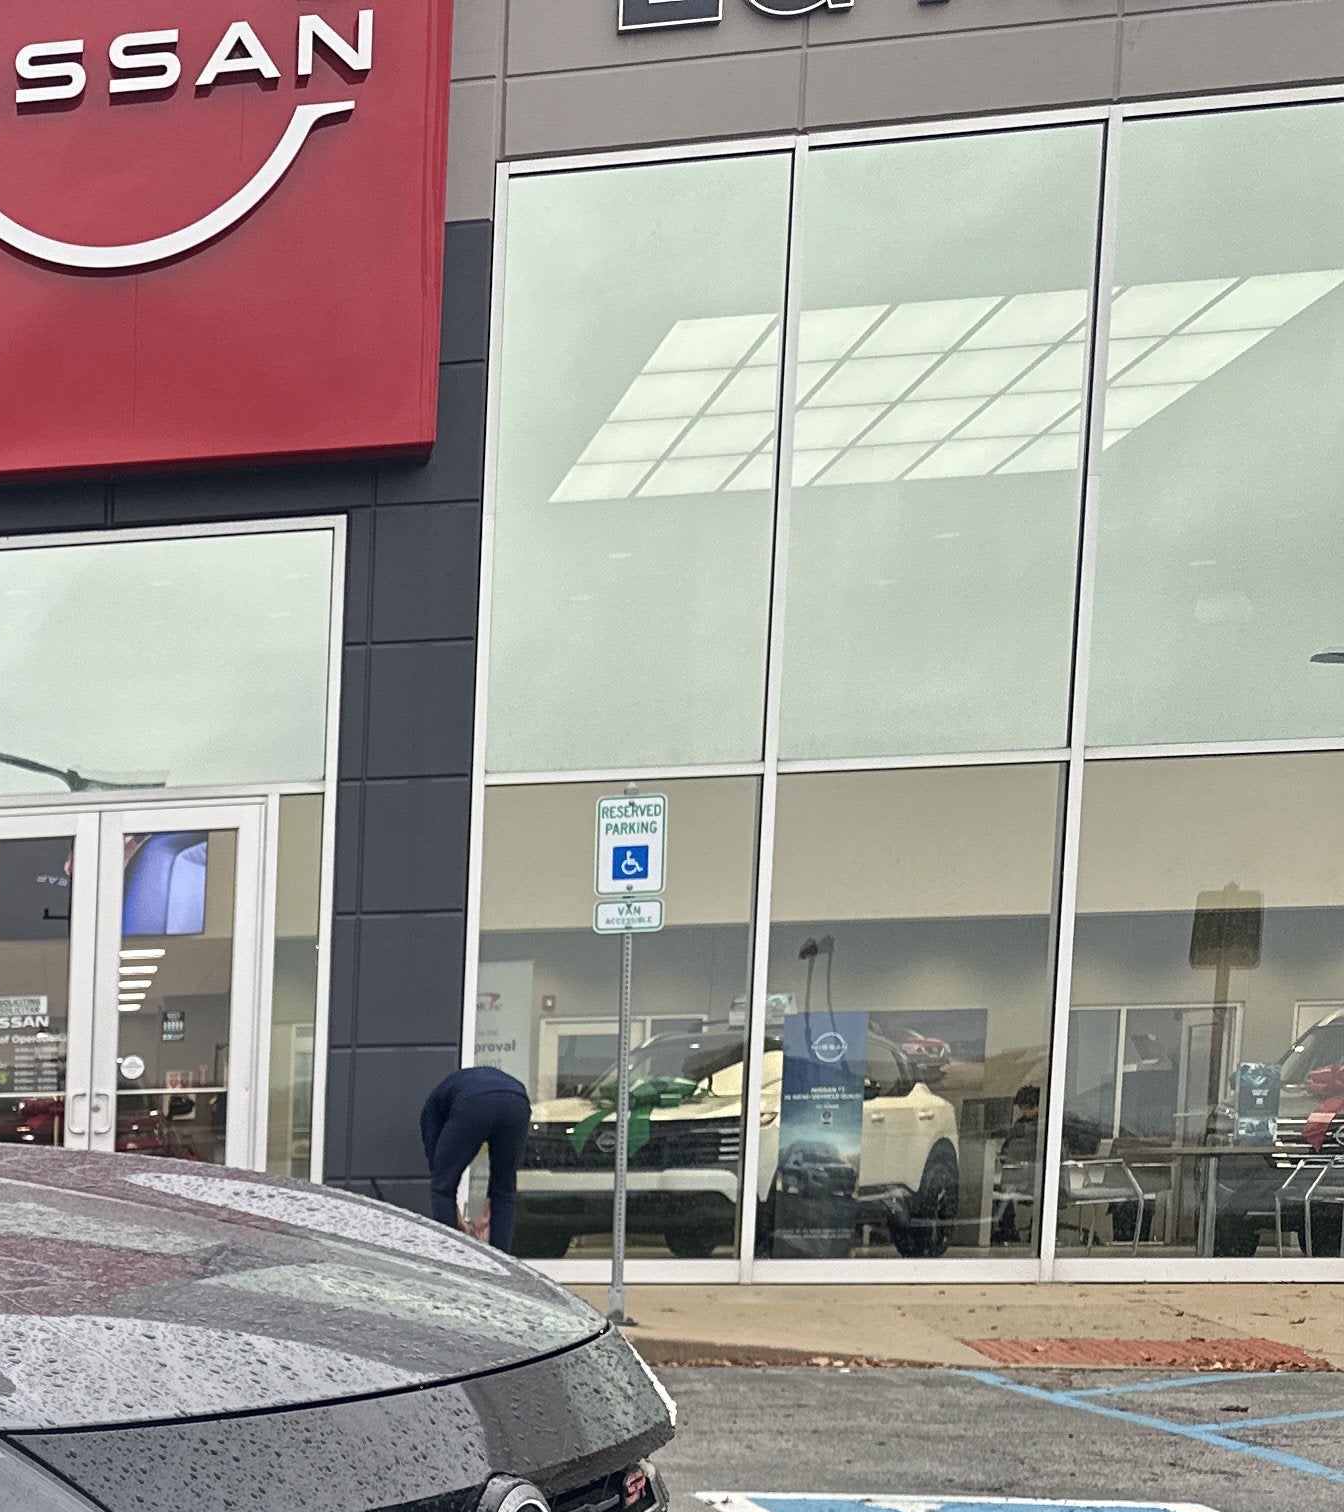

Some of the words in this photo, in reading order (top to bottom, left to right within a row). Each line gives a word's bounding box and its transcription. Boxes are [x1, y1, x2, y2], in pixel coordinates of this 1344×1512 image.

[601, 804, 661, 819] RESERVED
[605, 821, 658, 835] PARKING
[618, 905, 641, 917] VAN
[606, 916, 652, 925] ACCESSIBLE
